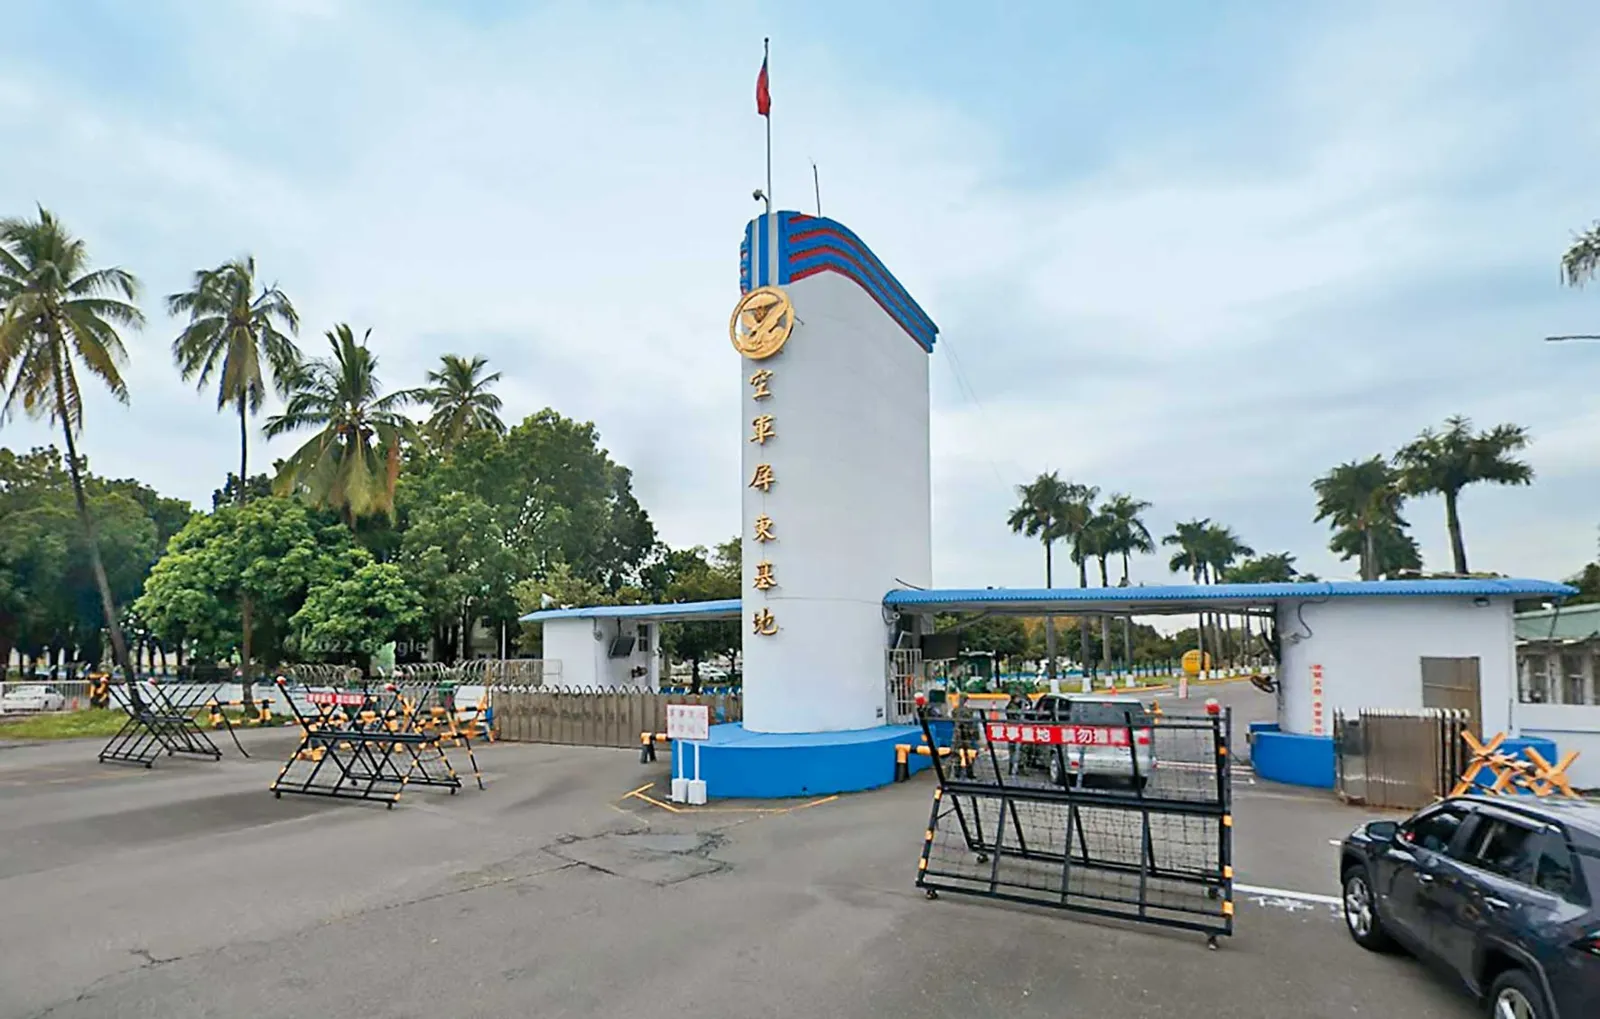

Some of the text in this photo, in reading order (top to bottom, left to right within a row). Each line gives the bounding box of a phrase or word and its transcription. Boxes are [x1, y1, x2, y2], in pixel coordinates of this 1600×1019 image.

[748, 369, 778, 636] 空軍屏東基地
